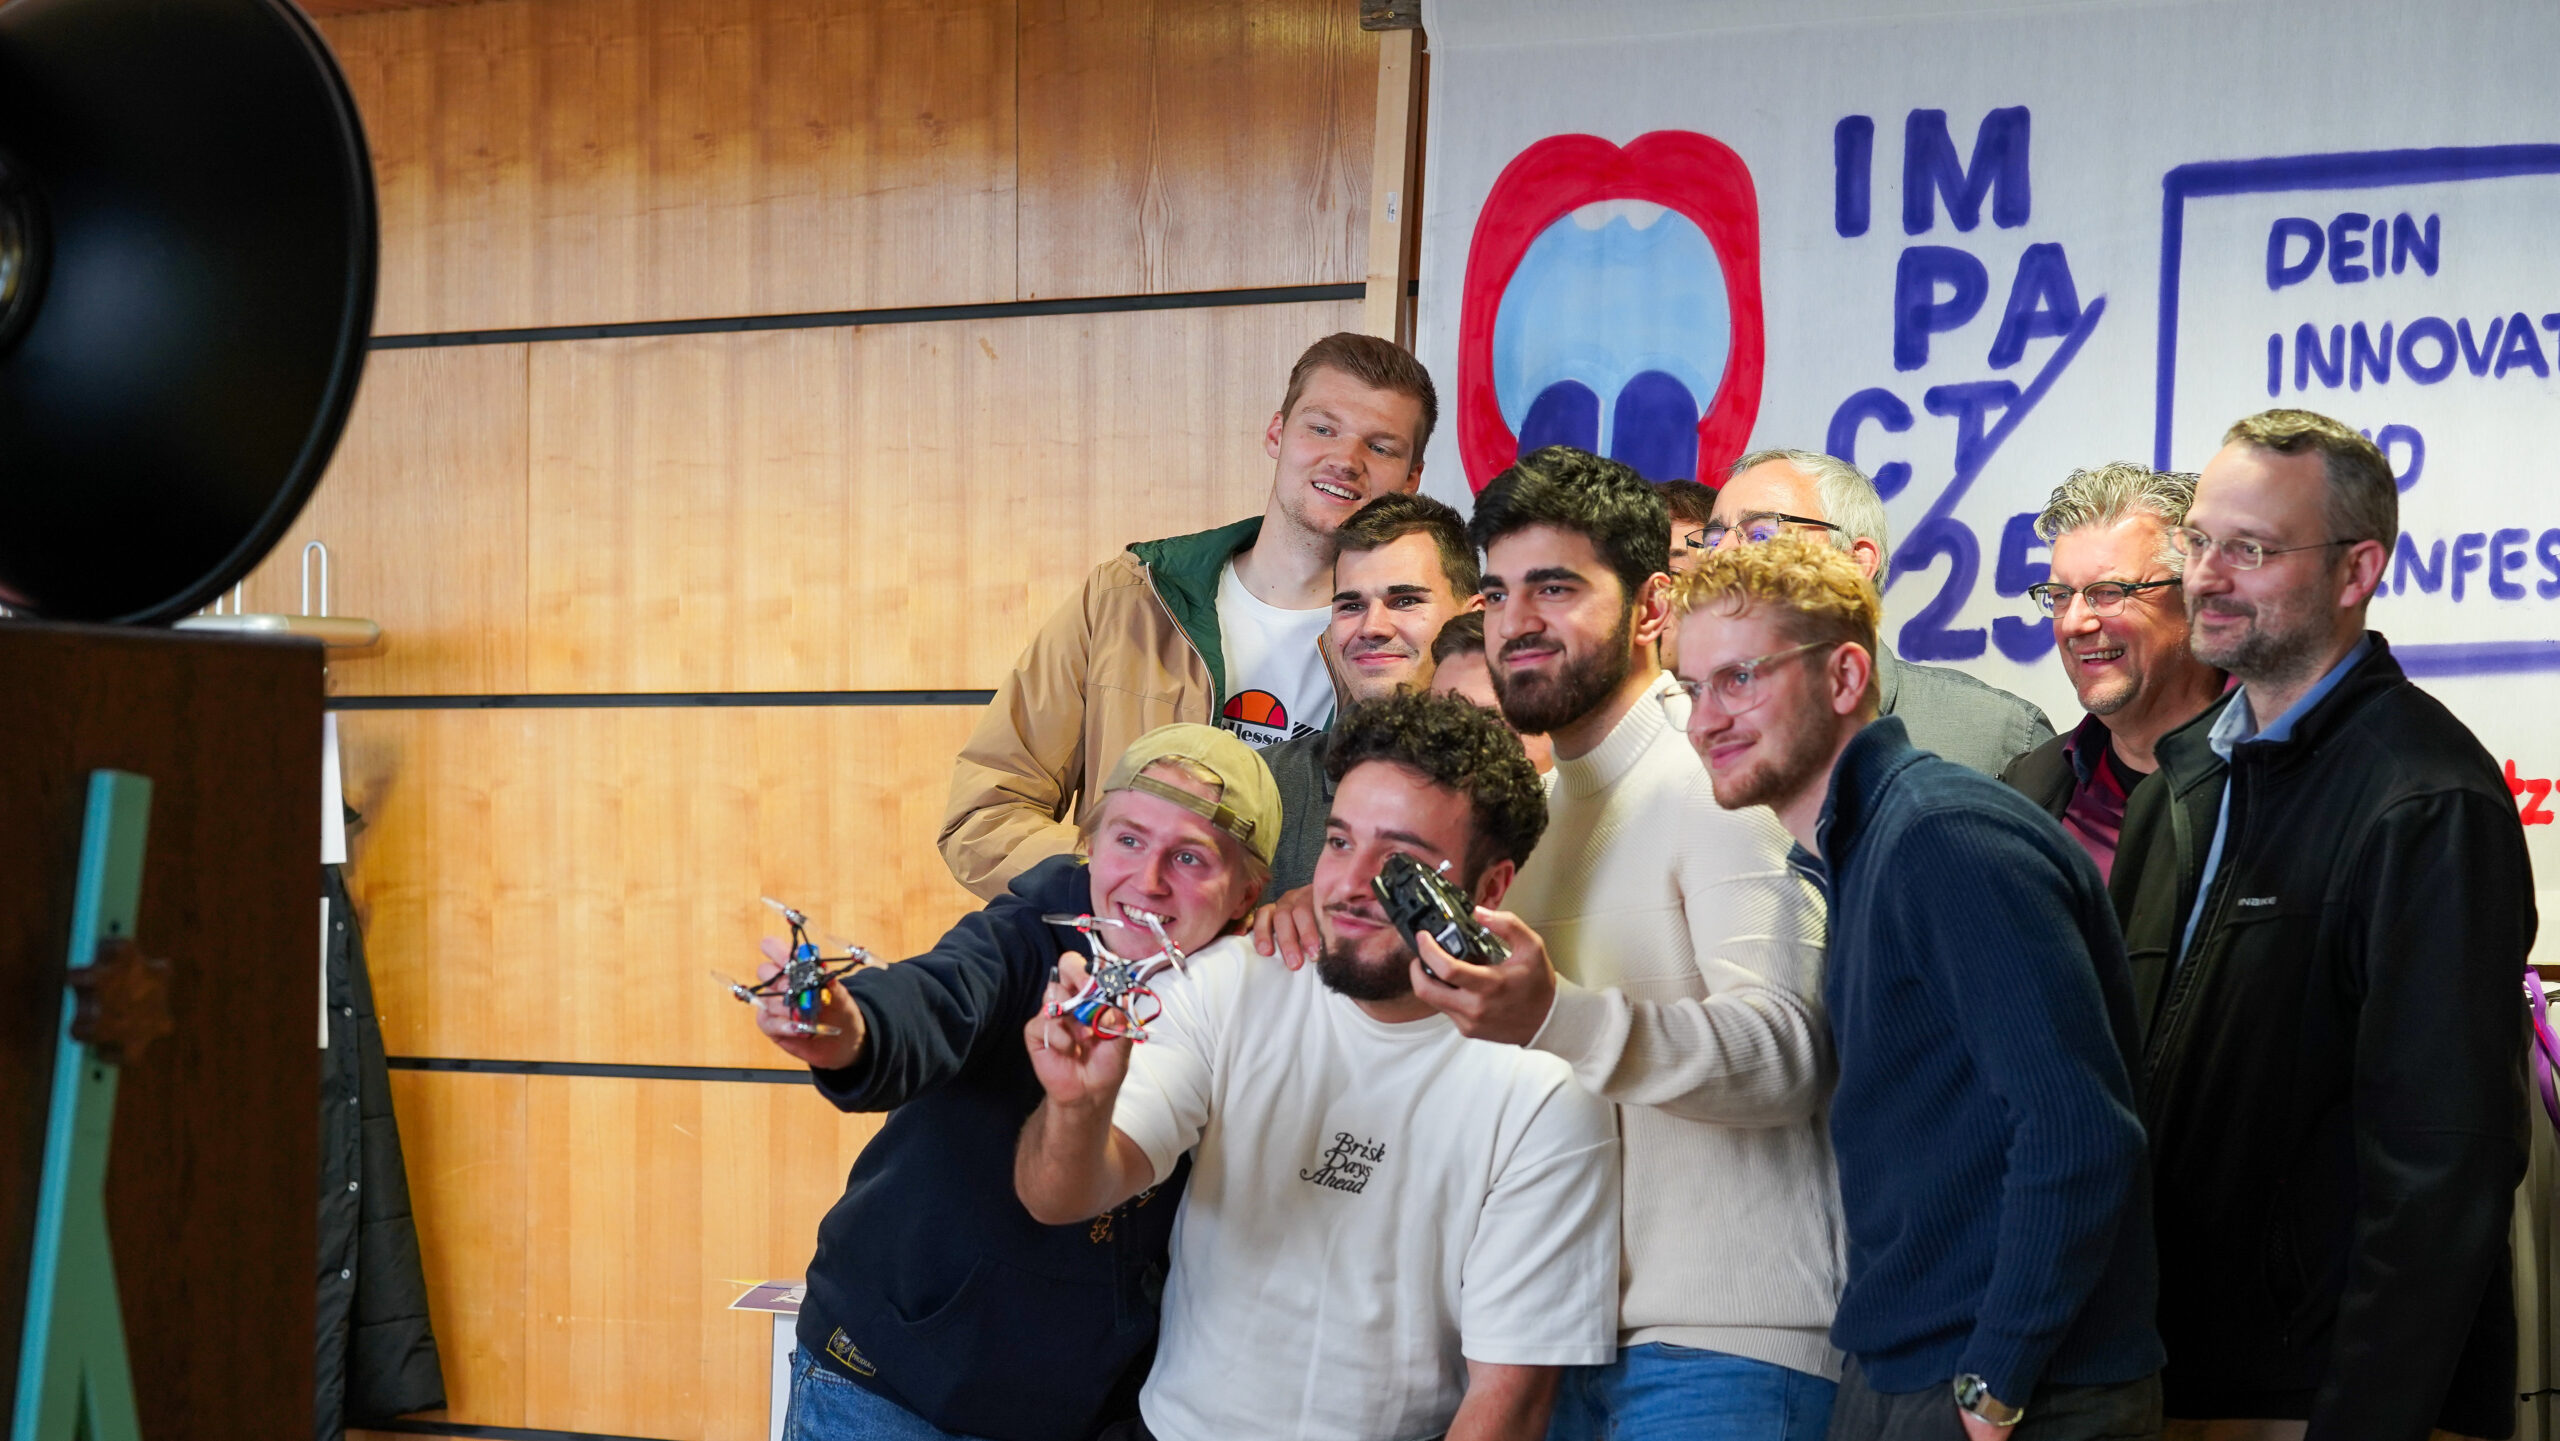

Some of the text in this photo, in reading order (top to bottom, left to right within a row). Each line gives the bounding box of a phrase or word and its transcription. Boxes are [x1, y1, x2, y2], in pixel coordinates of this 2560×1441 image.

[1834, 105, 2031, 238] IM
[2266, 212, 2440, 290] DEIN
[1894, 242, 2083, 371] PA
[1898, 513, 2057, 664] 25
[2375, 528, 2560, 603] NFES
[1221, 721, 1284, 745] llesse
[1300, 1167, 1368, 1194] Ahead
[1324, 1149, 1373, 1178] Days
[1335, 1132, 1386, 1163] Brisk
